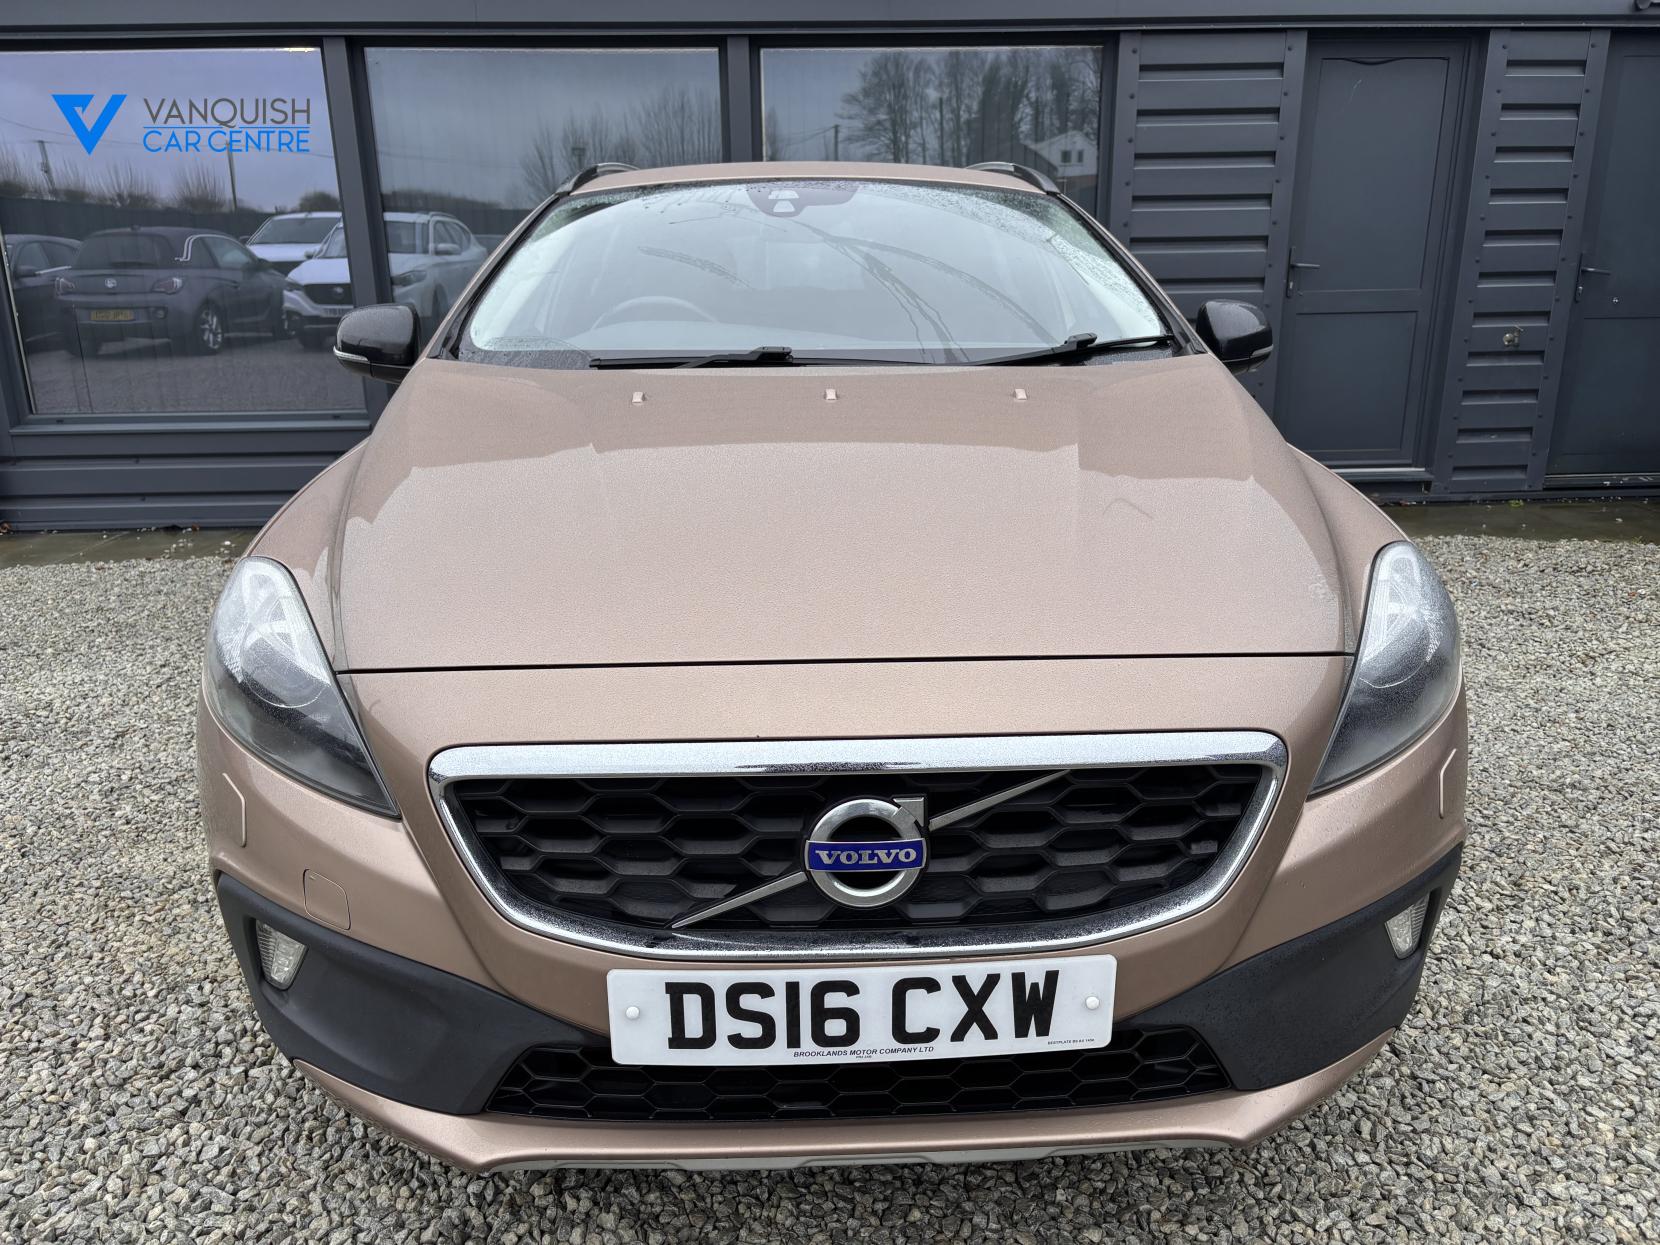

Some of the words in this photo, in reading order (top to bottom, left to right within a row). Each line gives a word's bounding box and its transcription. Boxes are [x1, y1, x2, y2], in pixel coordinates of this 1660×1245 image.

[815, 848, 917, 864] VOLVO
[665, 980, 860, 1050] DS16
[891, 969, 1060, 1044] CXW
[793, 1050, 848, 1058] BROOKLANDS
[879, 1047, 918, 1055] COMPANY
[918, 1045, 934, 1053] LTD
